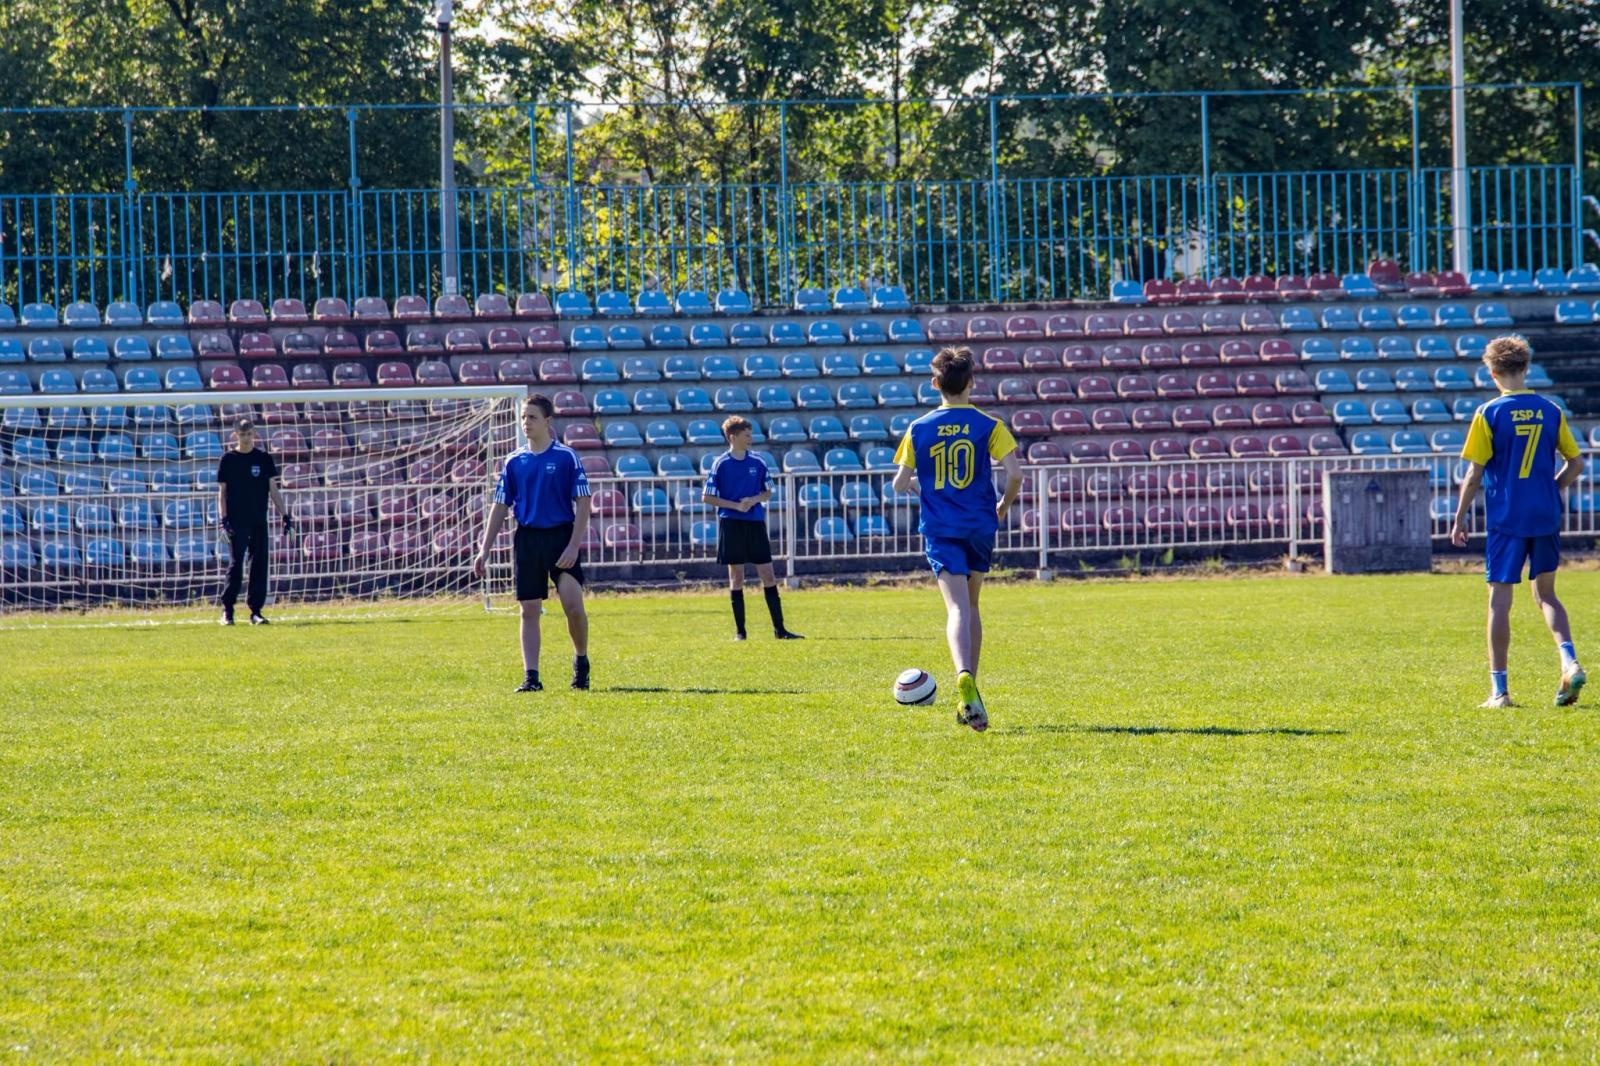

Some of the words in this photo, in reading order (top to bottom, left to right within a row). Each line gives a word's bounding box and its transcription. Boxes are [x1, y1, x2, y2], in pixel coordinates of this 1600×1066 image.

[937, 424, 960, 436] ZSP
[961, 423, 970, 435] 4
[1510, 409, 1534, 421] ZSP
[1536, 409, 1544, 420] 4
[929, 439, 976, 490] 10
[1515, 424, 1543, 479] 7
